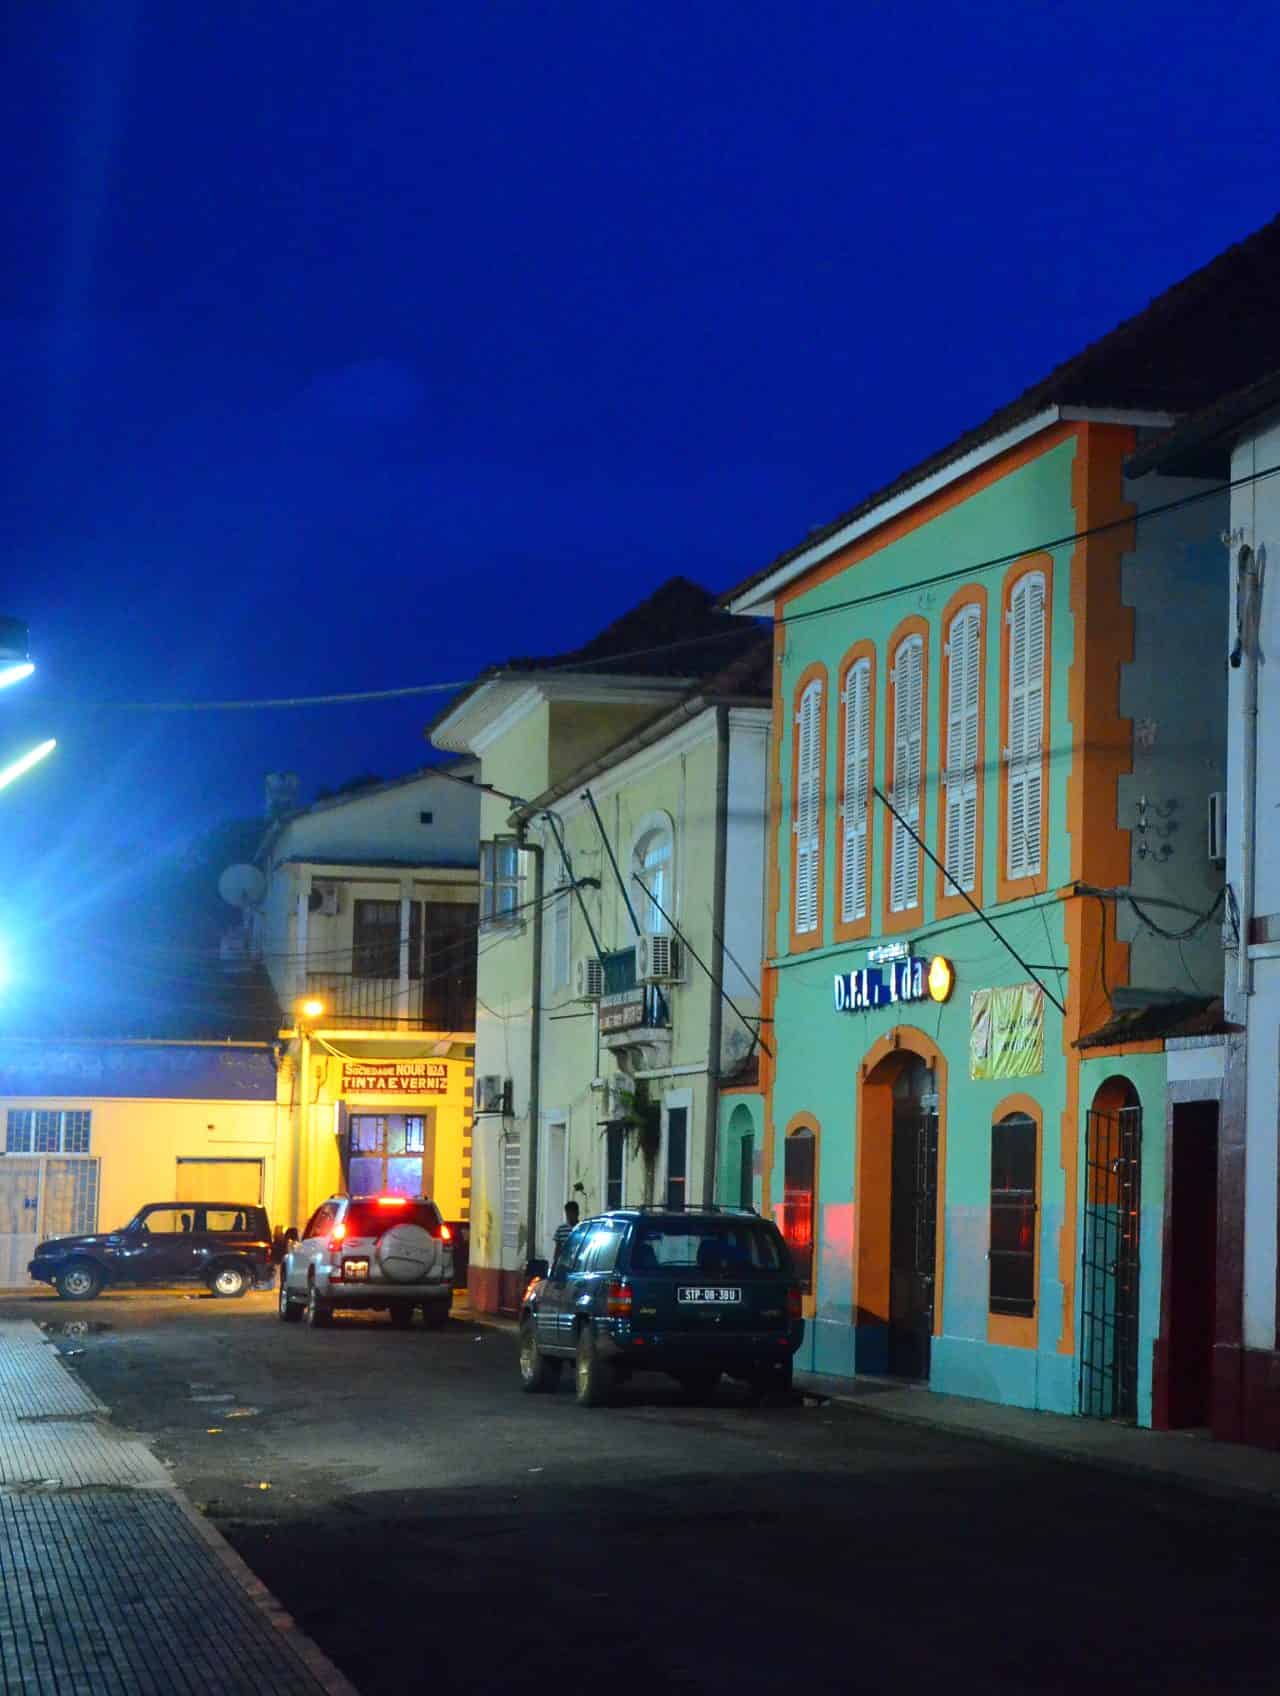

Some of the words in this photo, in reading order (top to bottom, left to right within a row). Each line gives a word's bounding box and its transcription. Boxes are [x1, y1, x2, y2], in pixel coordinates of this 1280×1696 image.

[396, 1063, 426, 1076] NOUR
[344, 1077, 387, 1089] TINTA
[400, 1077, 448, 1089] VERNIZ
